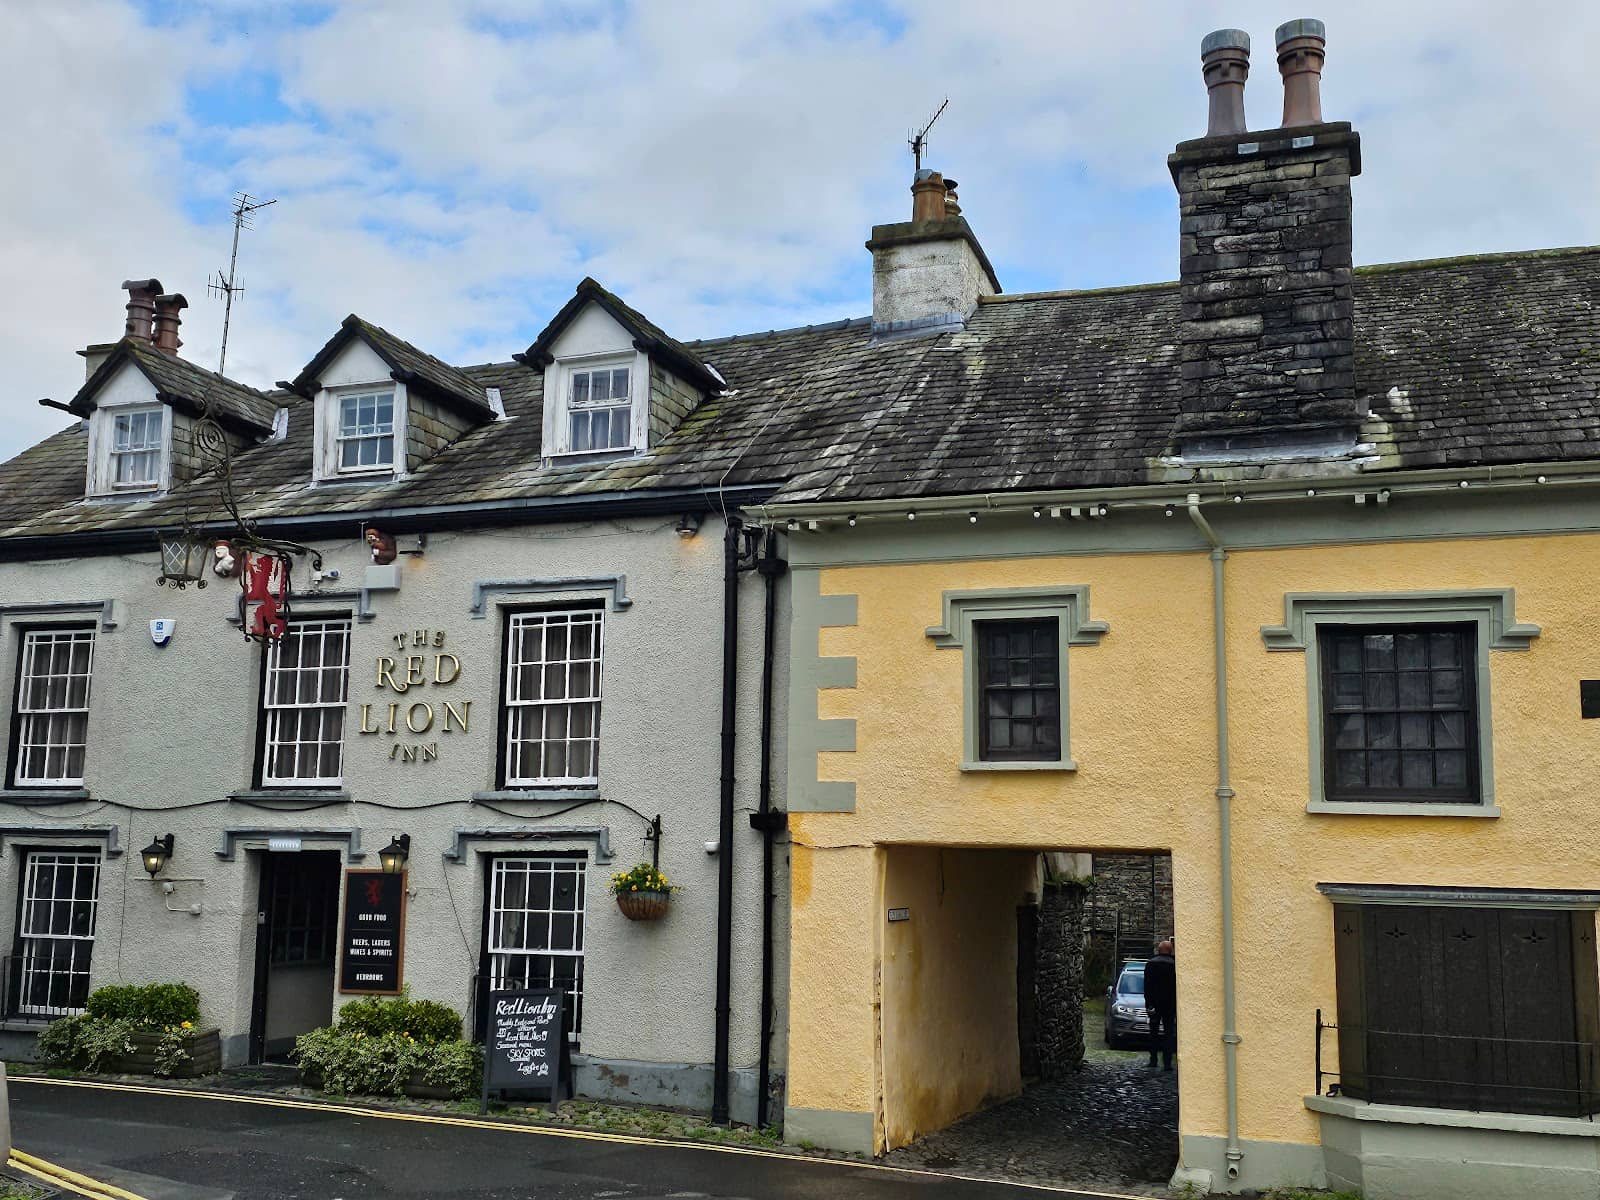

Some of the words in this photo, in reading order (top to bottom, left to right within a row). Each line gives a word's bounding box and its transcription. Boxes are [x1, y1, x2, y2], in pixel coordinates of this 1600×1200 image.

[393, 630, 446, 650] THE
[375, 653, 461, 694] RED
[359, 701, 472, 734] LION
[389, 743, 438, 762] INN
[358, 913, 372, 921] GOOD
[349, 948, 366, 956] WINES
[372, 949, 393, 957] SPIRITS
[371, 939, 391, 947] LAGERS
[356, 973, 384, 981] BEDROOMS
[496, 998, 519, 1015] Red
[516, 998, 541, 1015] Lion
[541, 996, 557, 1014] Inn
